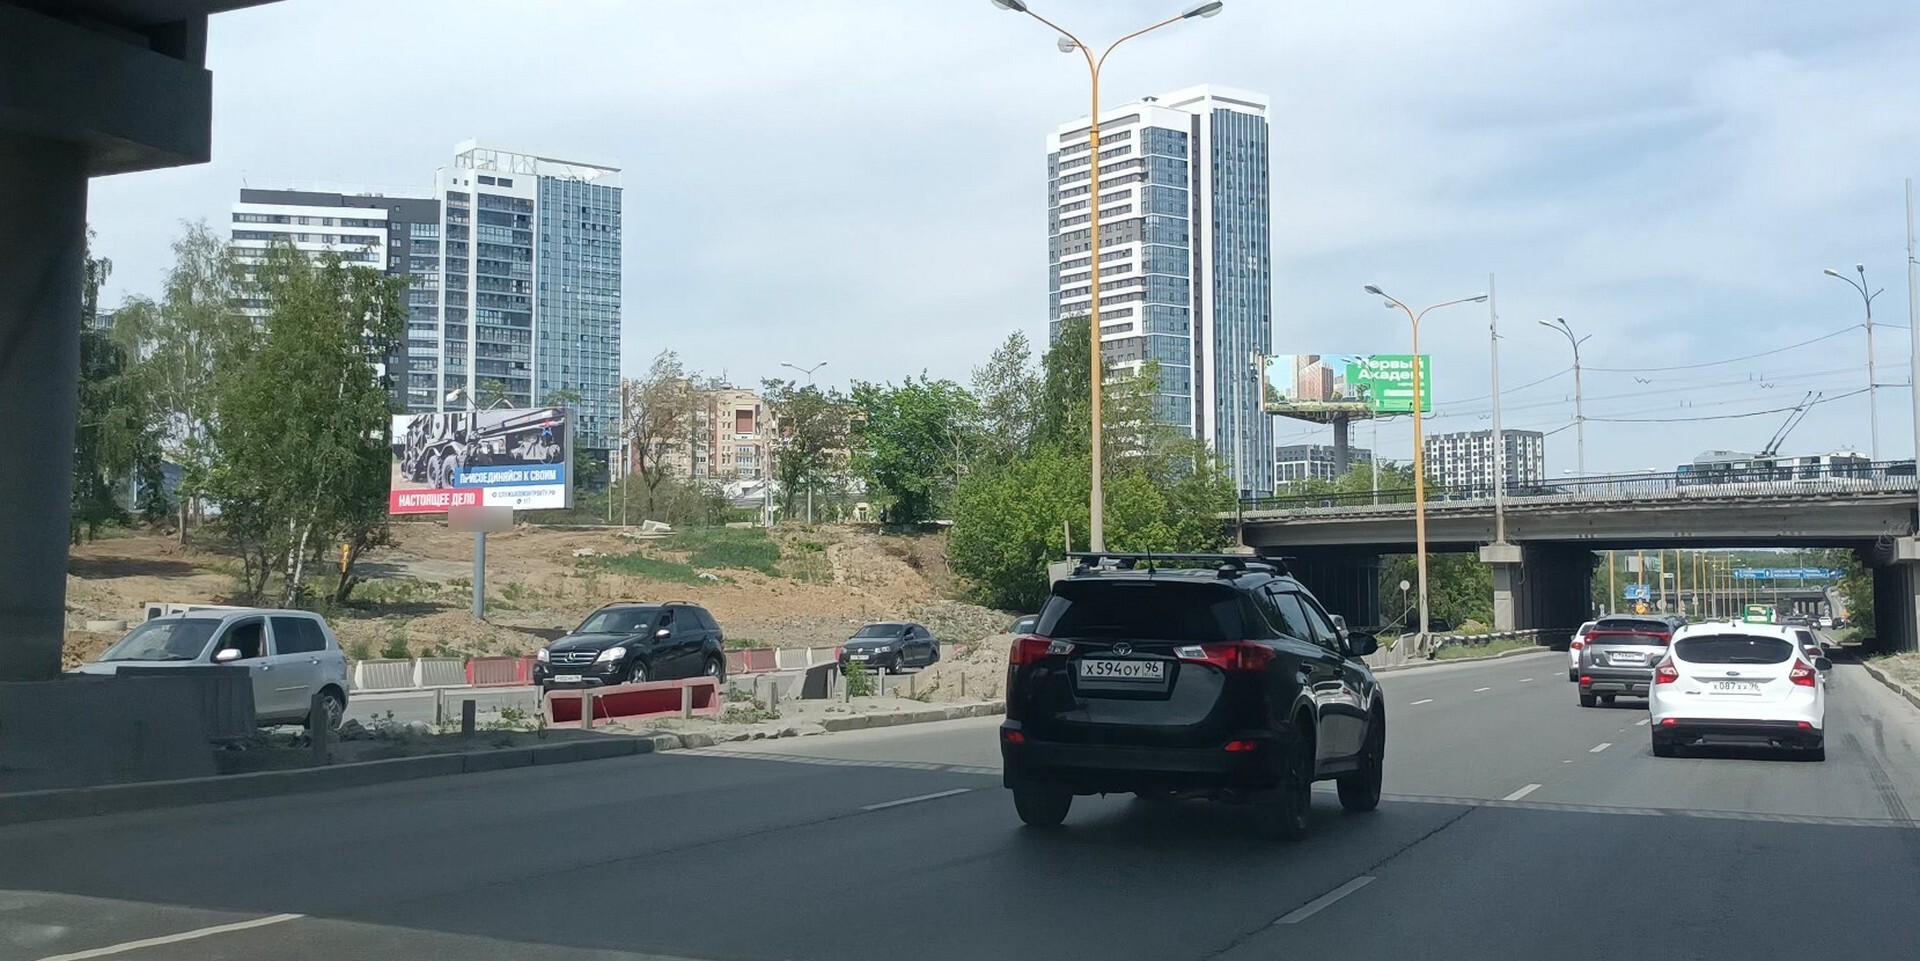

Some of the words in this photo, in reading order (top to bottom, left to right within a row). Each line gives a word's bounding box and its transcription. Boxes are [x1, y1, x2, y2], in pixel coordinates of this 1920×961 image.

[459, 470, 523, 484] ПРИСОЕДИНЯЙСЯ
[523, 470, 530, 481] К
[530, 469, 557, 481] СВОИМ
[398, 494, 450, 507] НАСТОЯЩЕЕ
[452, 493, 476, 507] ДЕЛО
[1145, 662, 1159, 673] 96
